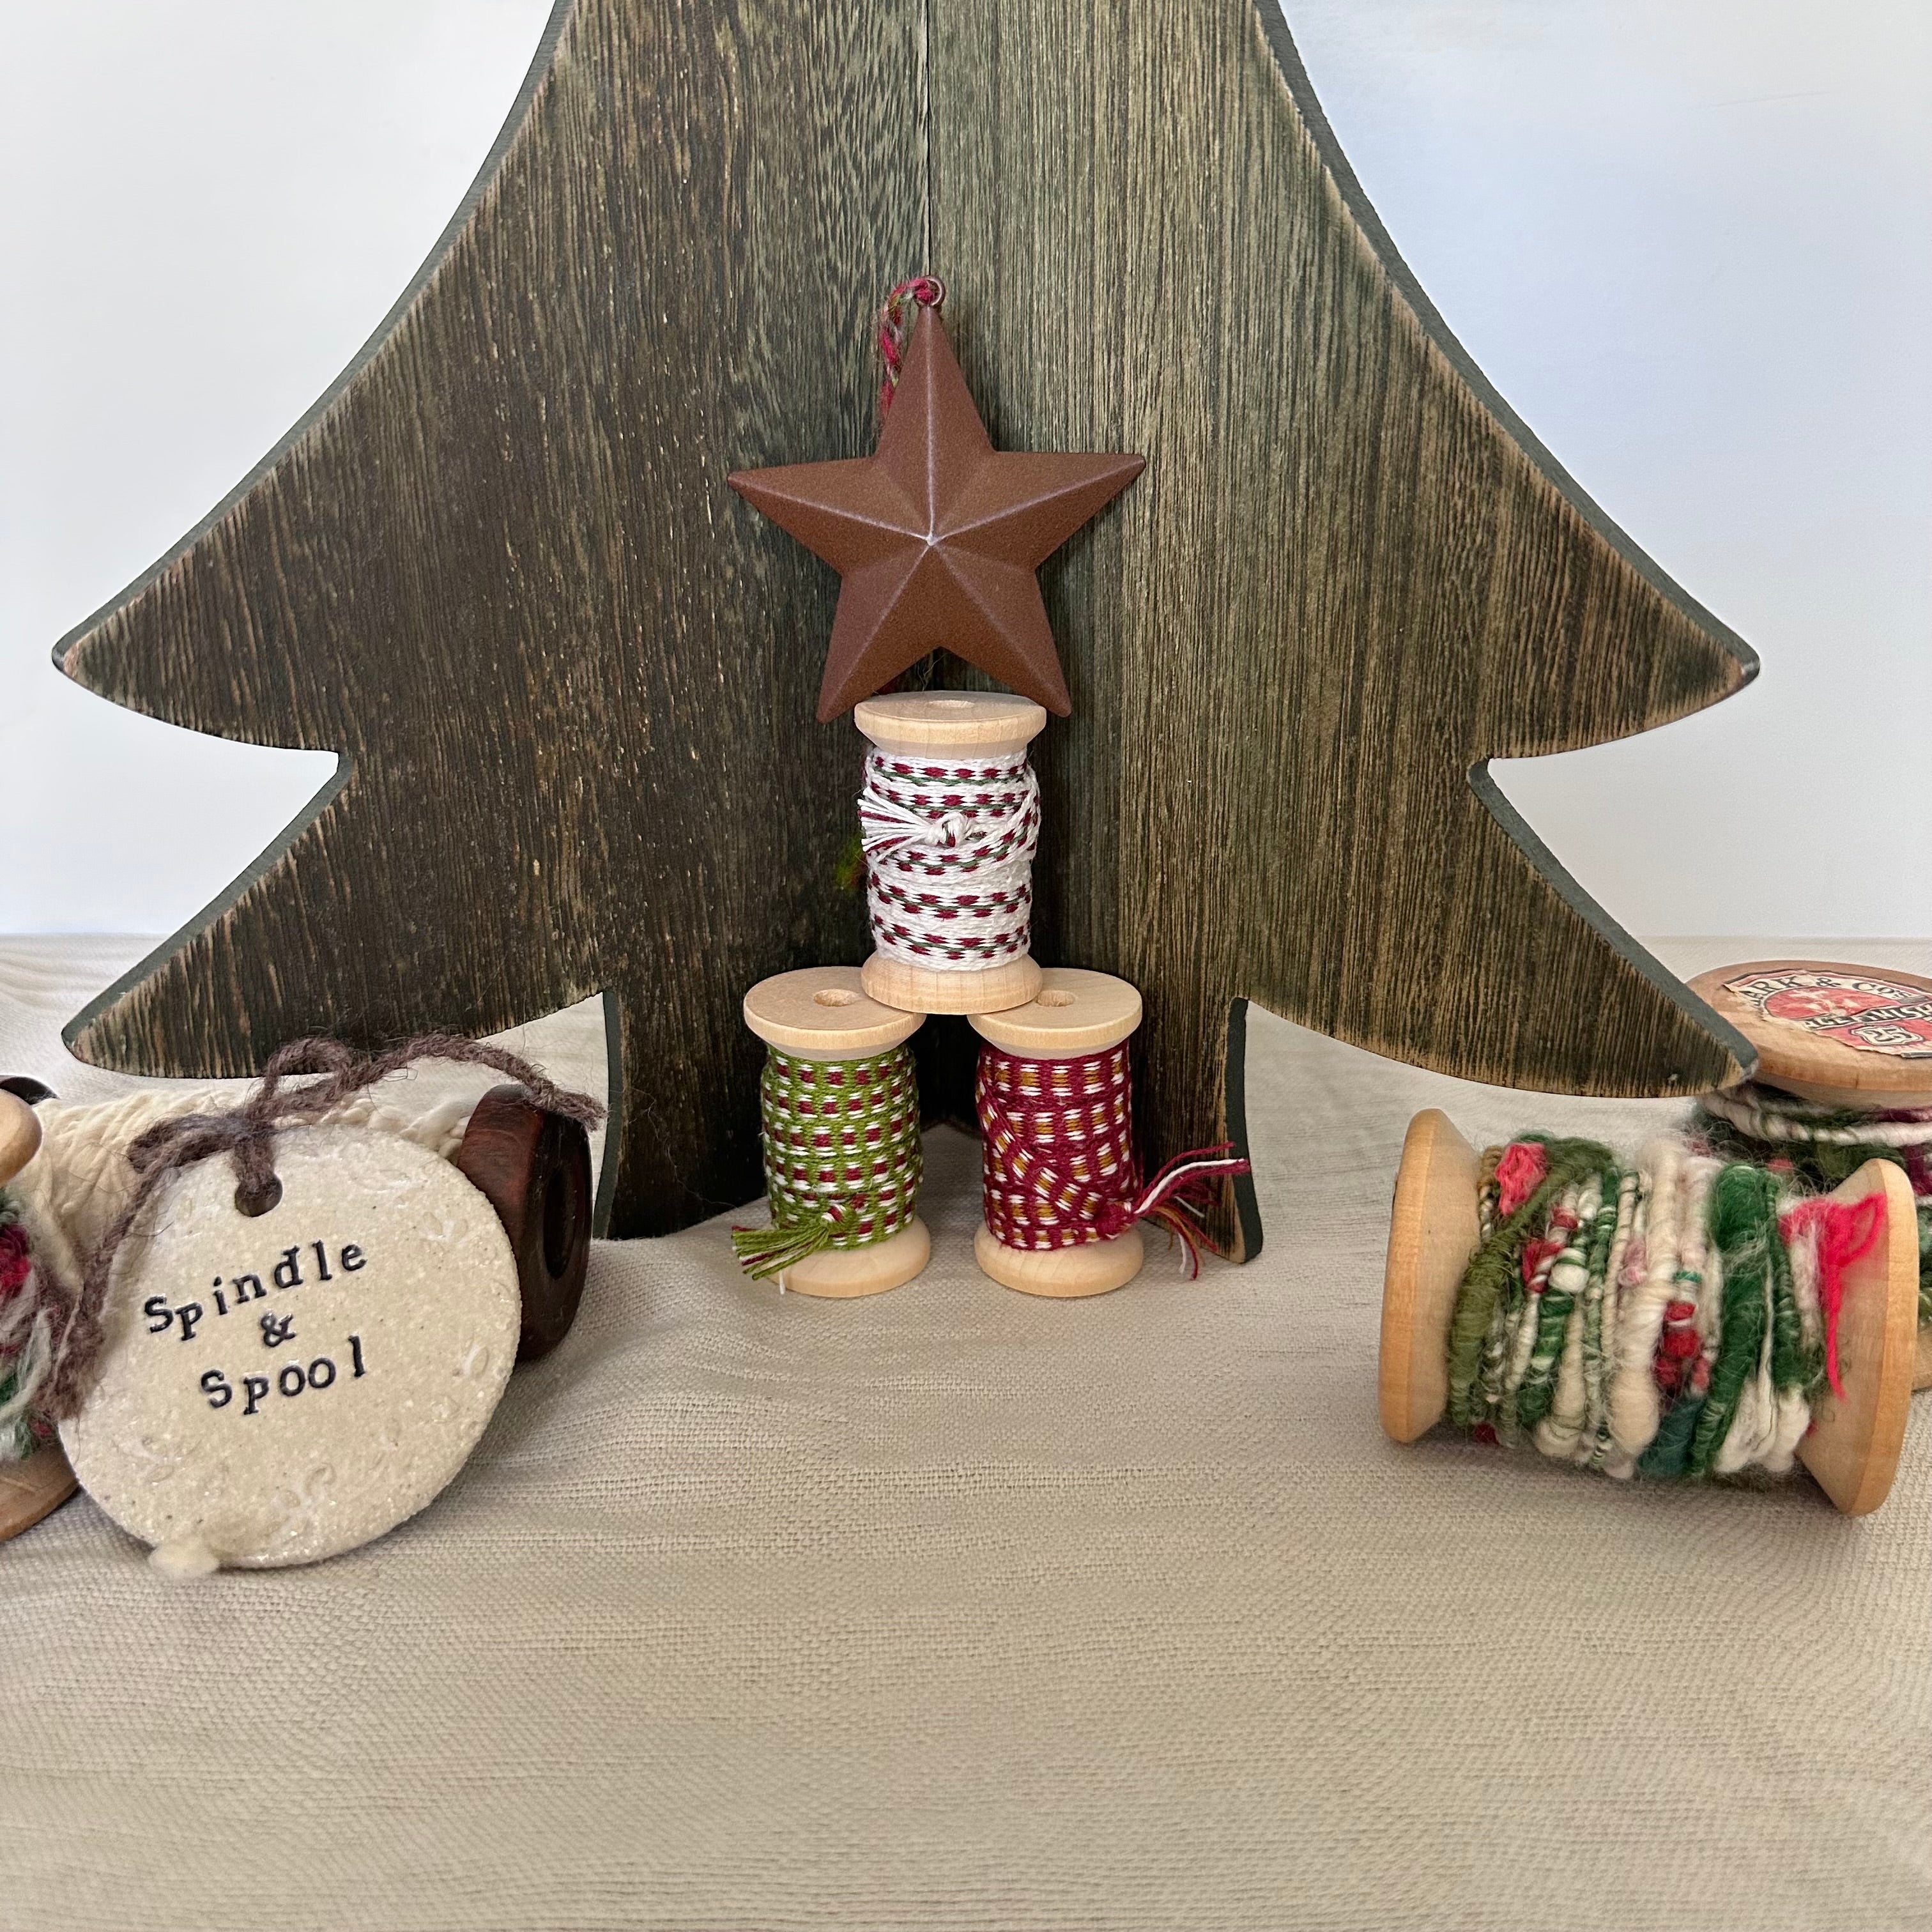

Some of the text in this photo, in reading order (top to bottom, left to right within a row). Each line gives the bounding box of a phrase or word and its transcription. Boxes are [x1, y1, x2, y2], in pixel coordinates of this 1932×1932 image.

[1816, 977, 1841, 987] &
[1863, 1027, 1913, 1042] 25
[144, 1239, 368, 1341] Spindle
[261, 1311, 297, 1347] &
[201, 1334, 367, 1415] Spool
